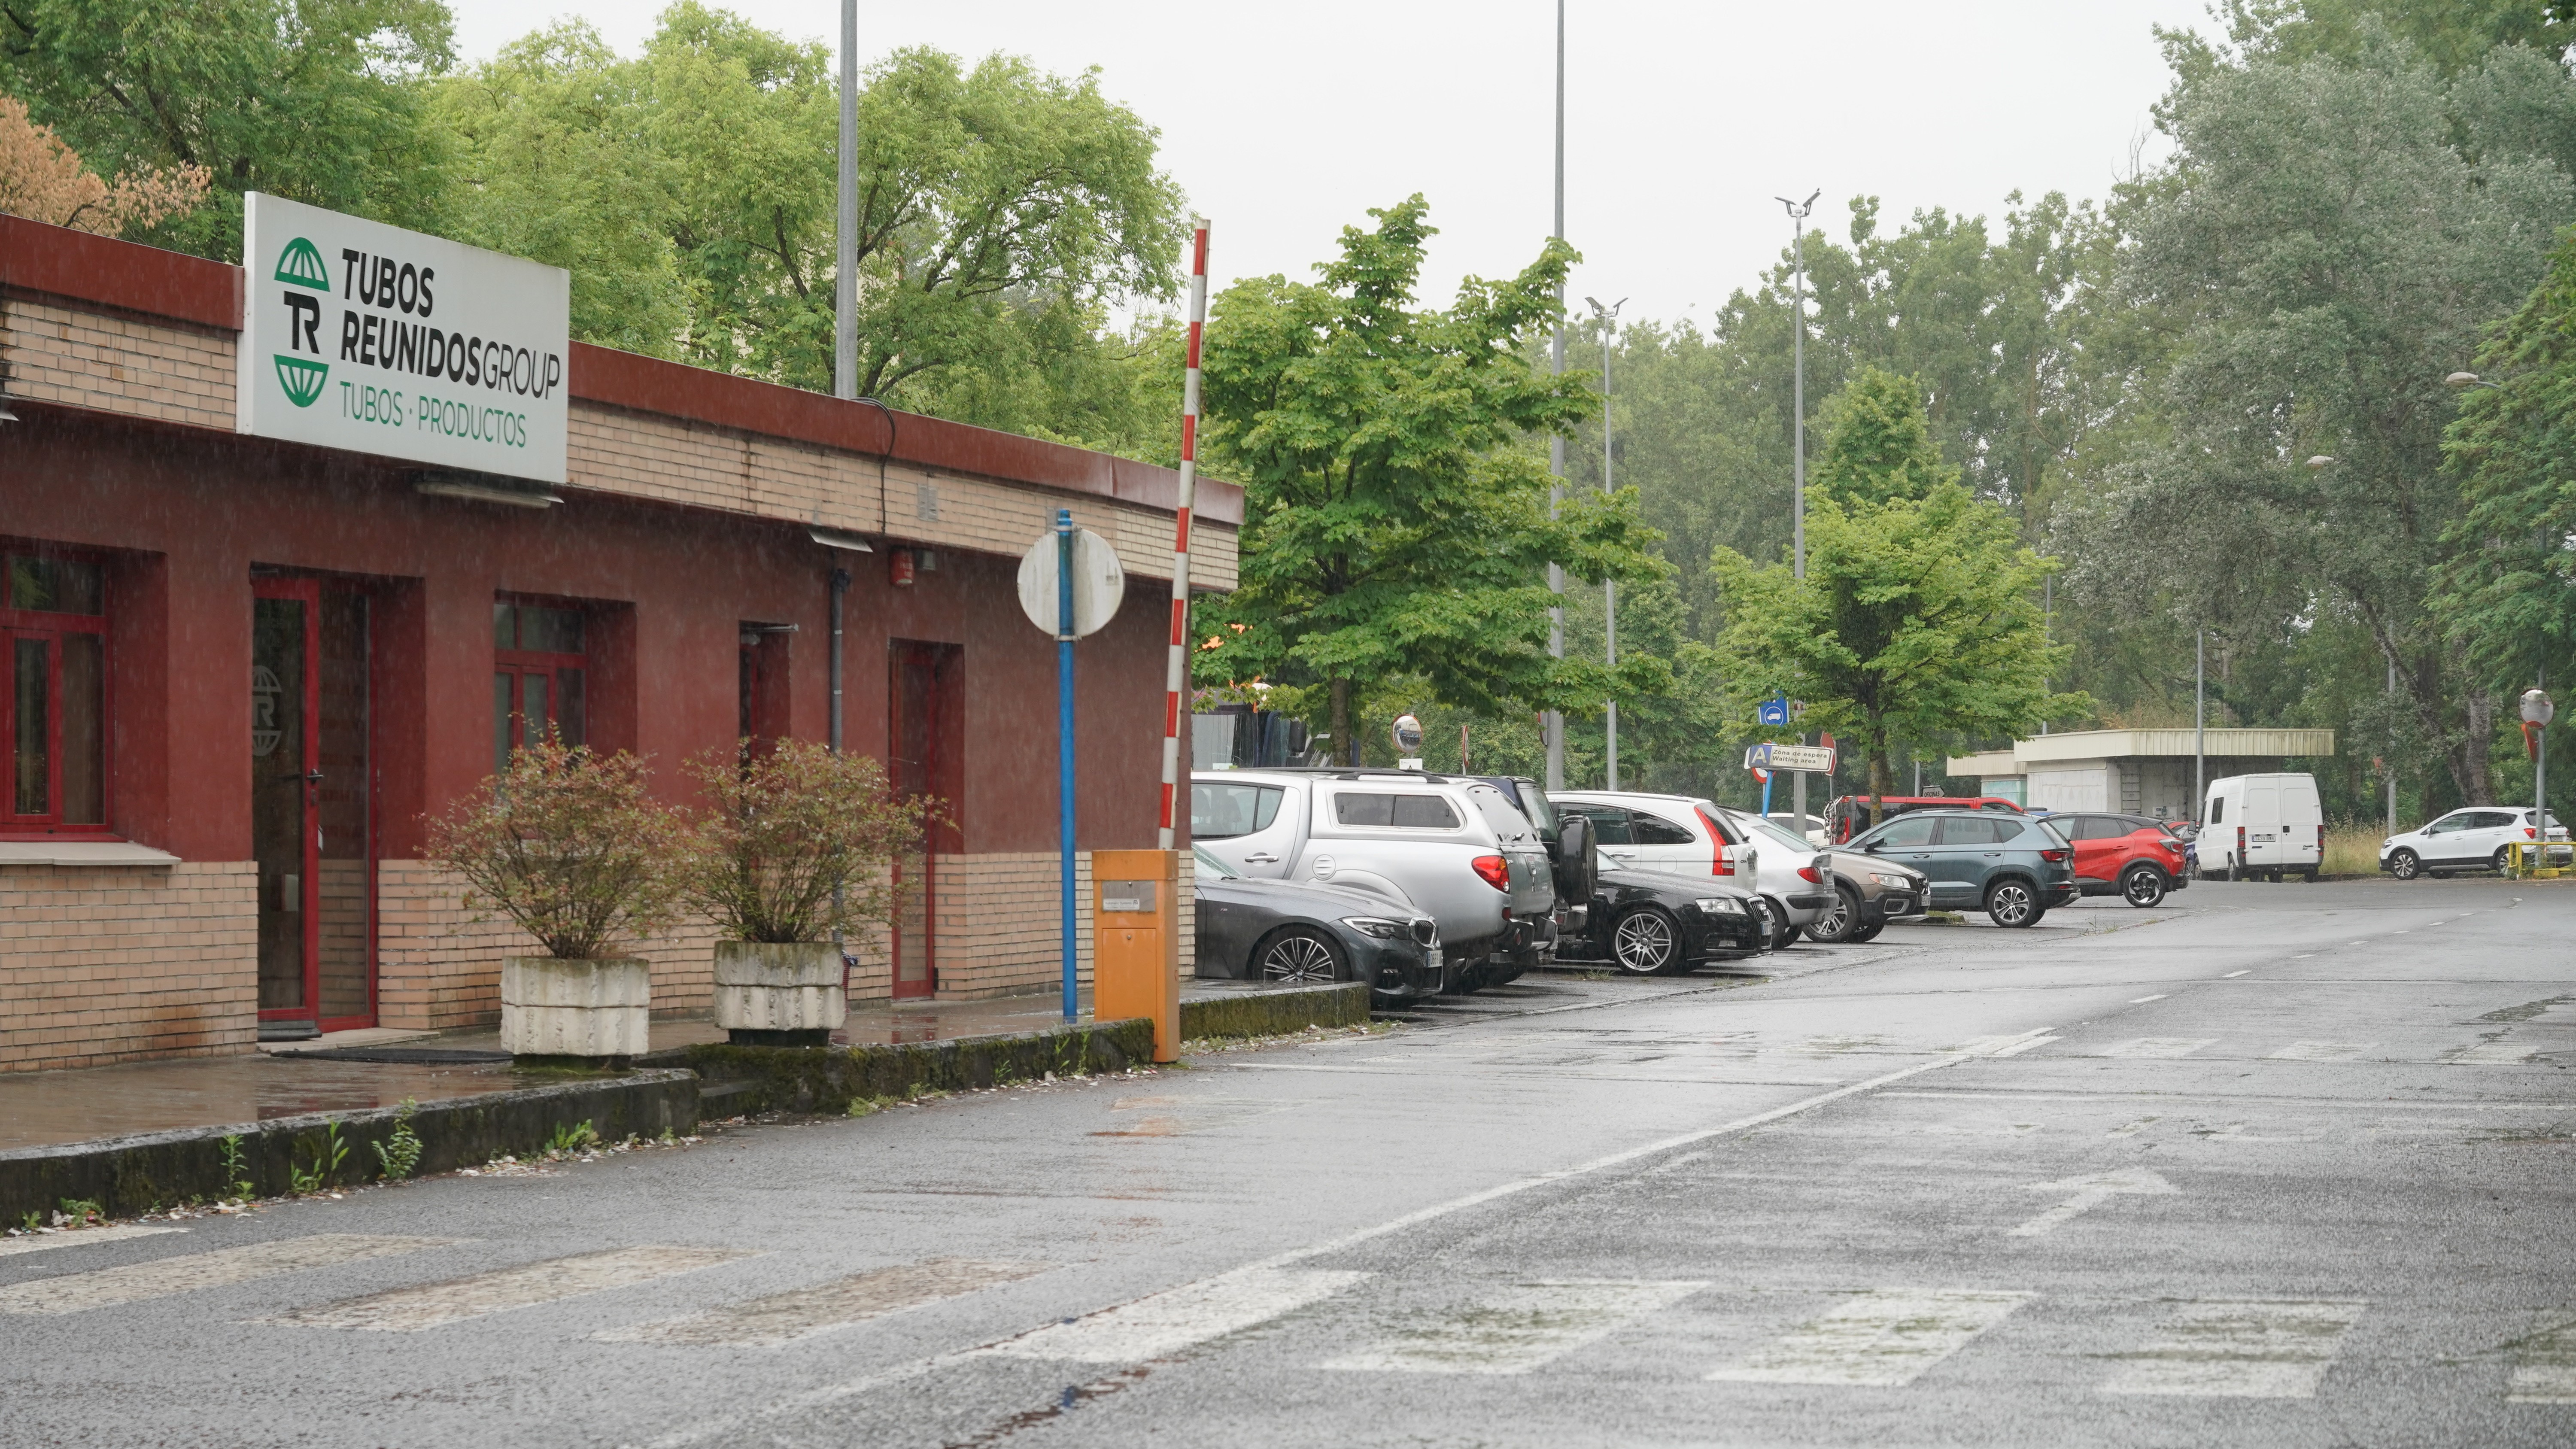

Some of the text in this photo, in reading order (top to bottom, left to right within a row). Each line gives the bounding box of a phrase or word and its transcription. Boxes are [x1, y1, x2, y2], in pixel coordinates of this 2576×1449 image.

[342, 248, 434, 318] TUBOS
[283, 291, 320, 354] TR
[340, 381, 403, 427] TUBOS
[419, 395, 526, 448] PRODUCTOS
[1751, 747, 1767, 763] A
